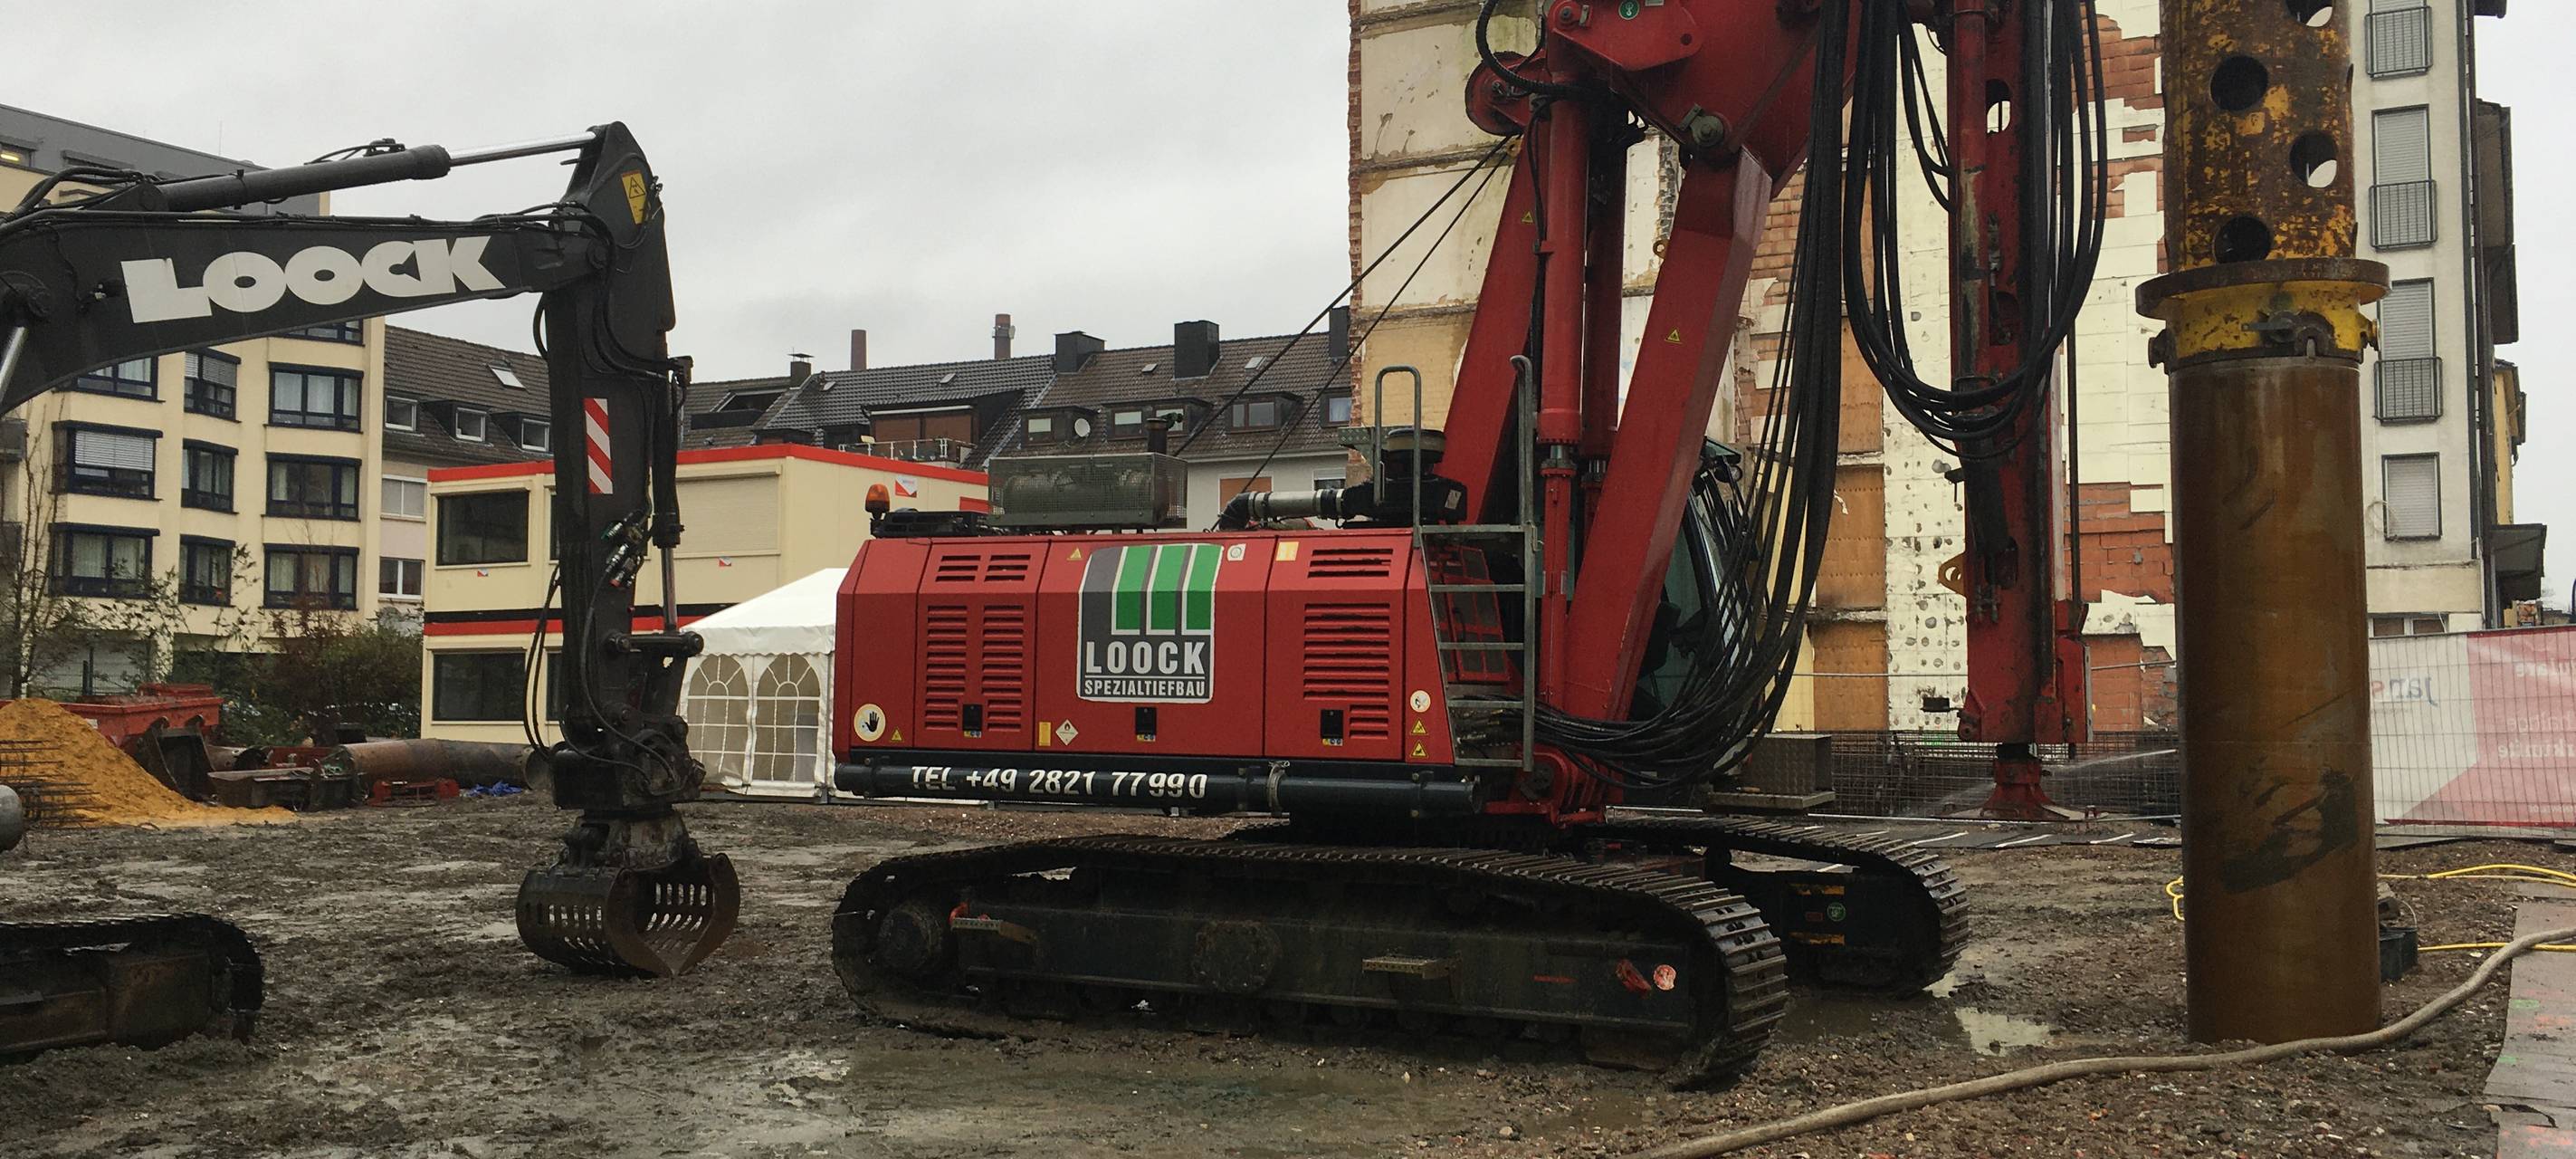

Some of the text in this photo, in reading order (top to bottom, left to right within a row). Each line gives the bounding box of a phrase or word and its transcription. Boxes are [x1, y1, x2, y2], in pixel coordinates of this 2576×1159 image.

[120, 235, 506, 323] LOOCK
[1086, 641, 1205, 674] LOOCK
[1084, 679, 1205, 696] SPEZIALTIEFBAU
[911, 766, 1207, 799] TEL +49 2821 77990
